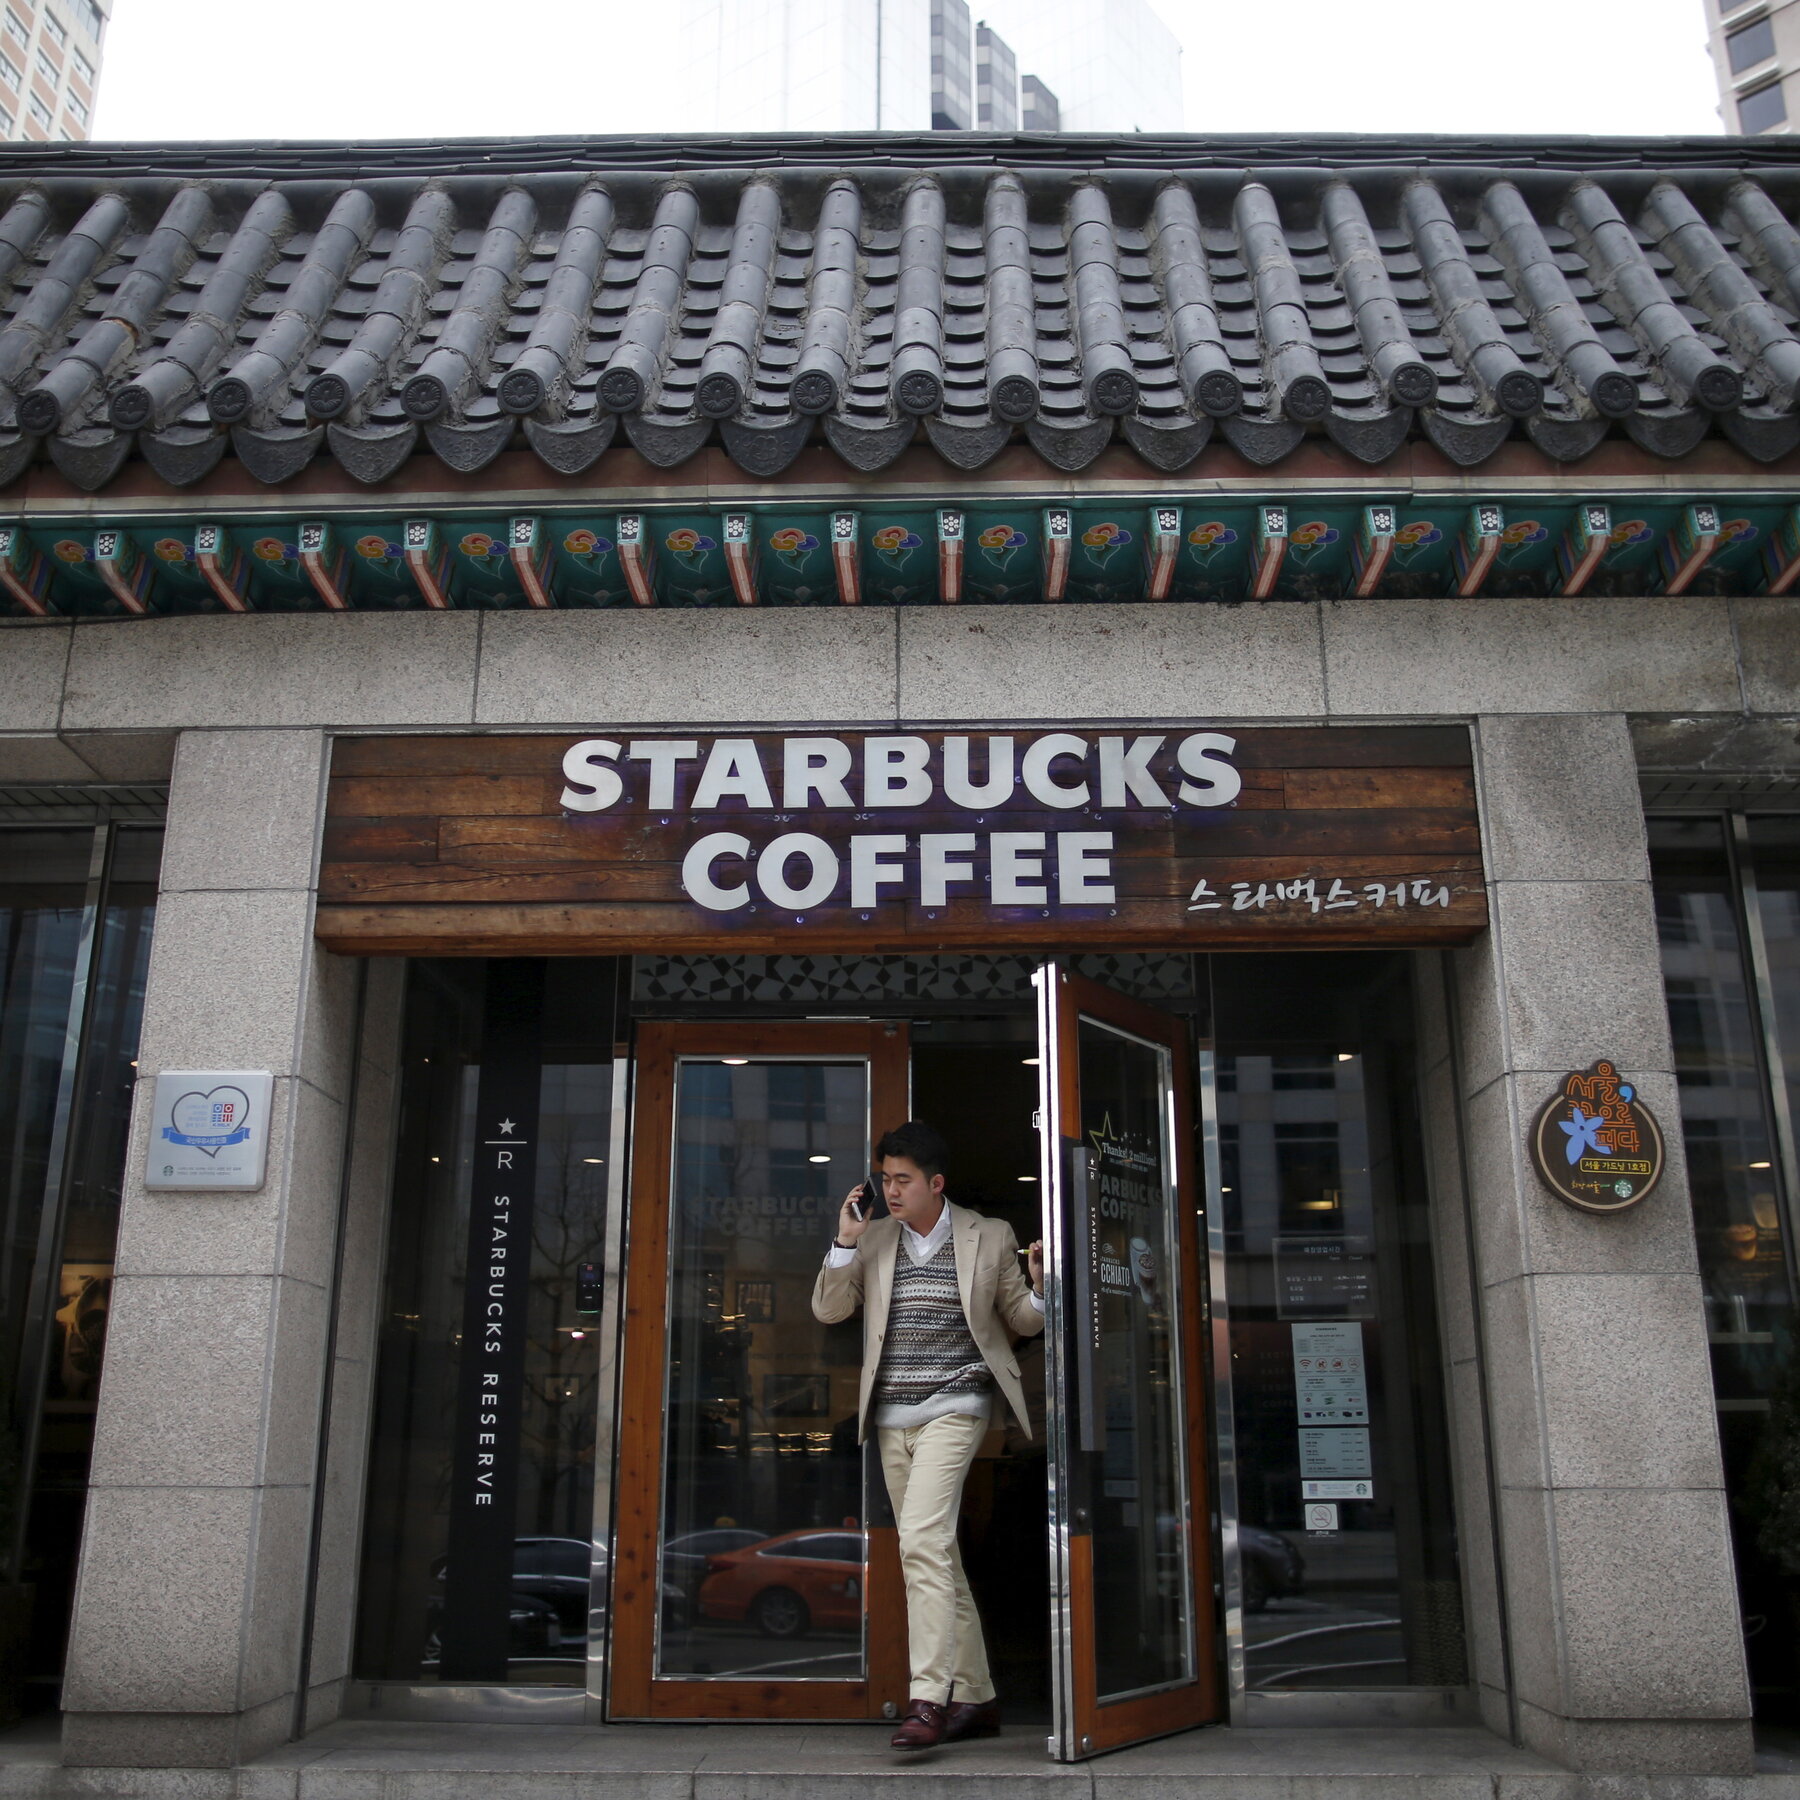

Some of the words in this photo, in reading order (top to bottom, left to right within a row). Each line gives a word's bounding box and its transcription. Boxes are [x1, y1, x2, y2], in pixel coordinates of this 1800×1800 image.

[559, 733, 1242, 812] STARBUCKS
[681, 831, 1116, 911] COFFEE
[496, 1151, 513, 1169] R
[1101, 1142, 1128, 1159] Thanks!
[1128, 1149, 1134, 1160] 2
[1584, 1160, 1601, 1170] 서울
[1602, 1161, 1625, 1171] 가드닝
[1098, 1173, 1162, 1208] ARBUCKS
[1090, 1207, 1098, 1274] STARBUCKS
[484, 1195, 510, 1353] STARBUCKS
[1100, 1263, 1130, 1287] CCHIATO
[1092, 1293, 1101, 1349] RESERVE
[475, 1373, 499, 1505] RESERVE
